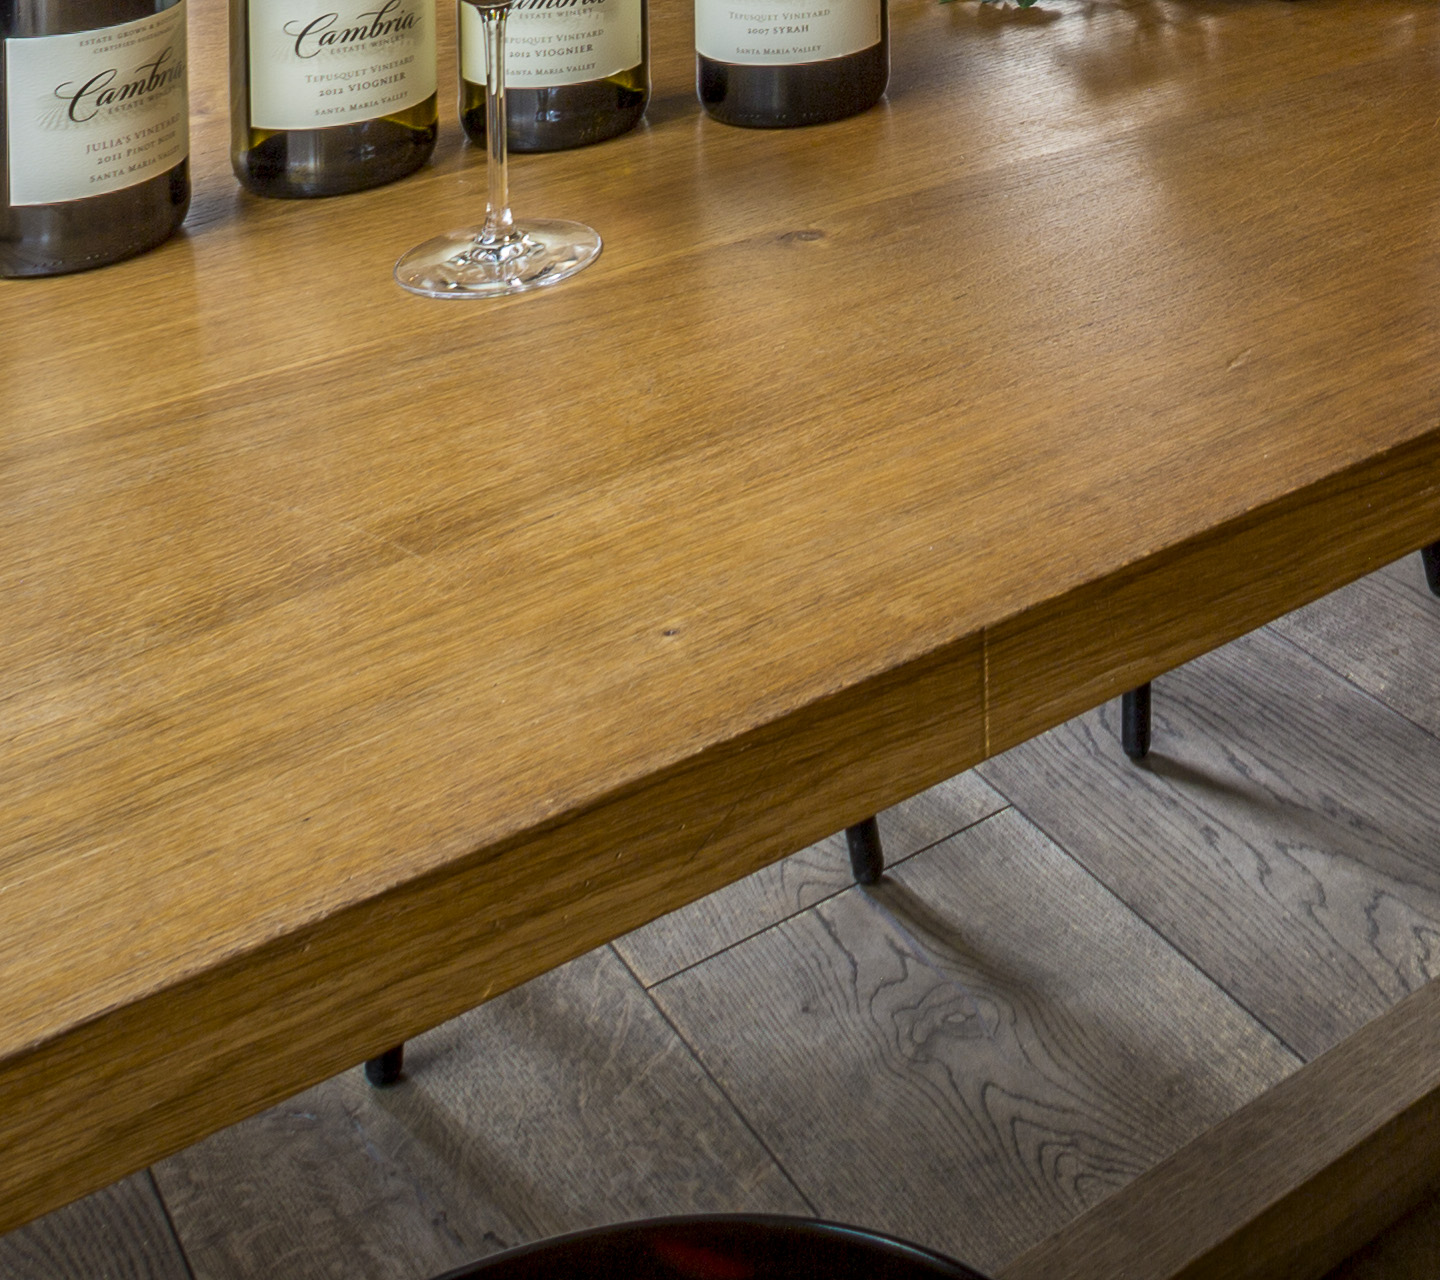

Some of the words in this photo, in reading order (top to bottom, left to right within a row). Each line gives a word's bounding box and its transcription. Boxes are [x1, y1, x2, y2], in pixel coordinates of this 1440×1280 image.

[728, 10, 779, 23] TEPUSQUET
[782, 7, 832, 21] VINEYARD
[505, 34, 554, 47] EPUSQUET
[556, 27, 605, 44] VINEYARD
[772, 24, 810, 35] SYRAH
[534, 43, 594, 58] VIOGNIER
[736, 46, 761, 55] SANTA
[763, 46, 791, 55] MARIA
[792, 43, 822, 55] VALLEY
[304, 68, 368, 85] TEPUSQUET
[370, 54, 415, 74] VINEYARD
[535, 65, 564, 76] MARIA
[566, 62, 597, 73] VALLEY
[318, 87, 344, 98] 2012
[348, 71, 407, 92] VIOGNIER
[314, 105, 346, 117] SANTA
[349, 99, 380, 113] MARIA
[381, 90, 409, 105] VALLEY
[86, 130, 132, 155] JULIA'S
[97, 151, 122, 166] 2011
[126, 139, 156, 157] PINOT
[89, 169, 125, 184] SANTA
[128, 156, 157, 172] MARIA
